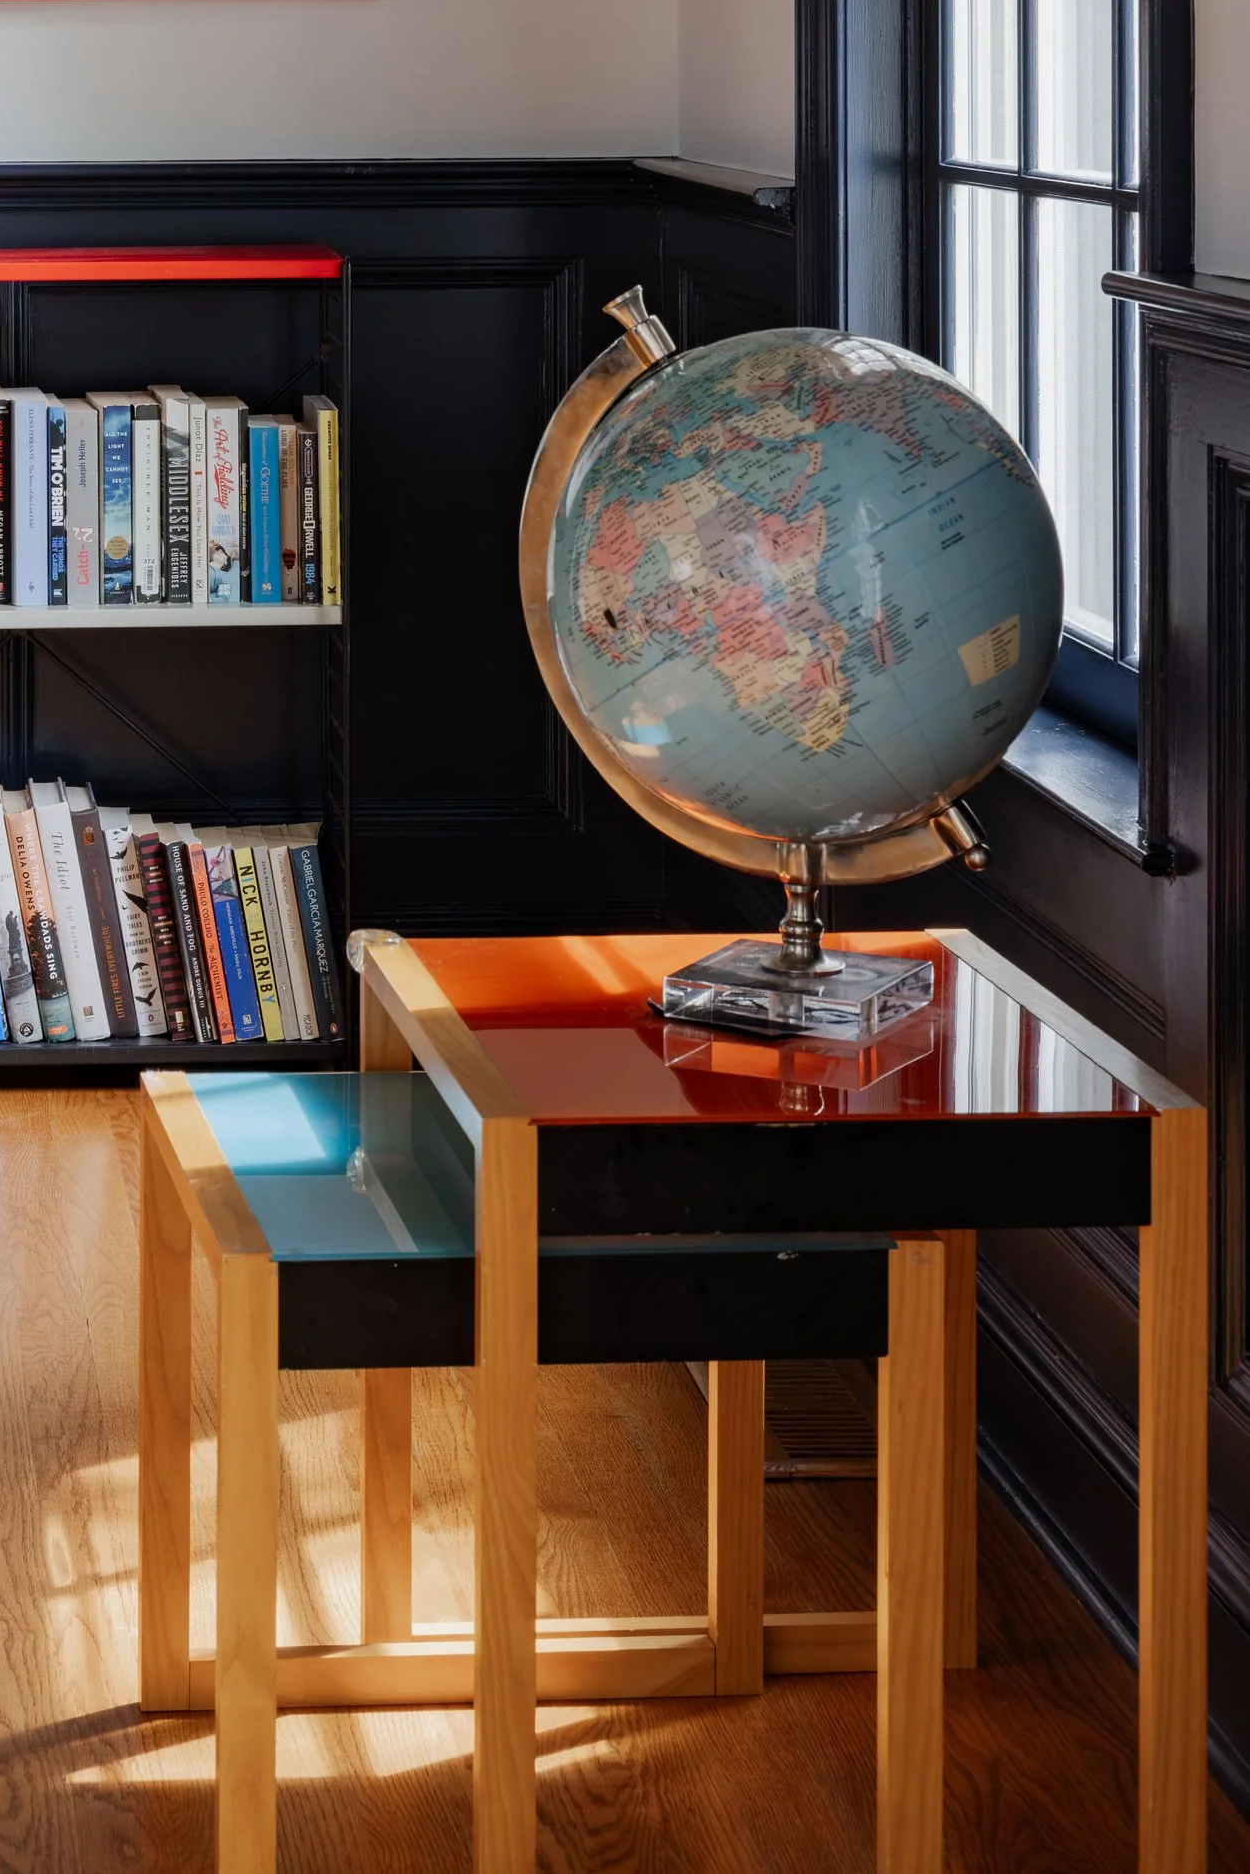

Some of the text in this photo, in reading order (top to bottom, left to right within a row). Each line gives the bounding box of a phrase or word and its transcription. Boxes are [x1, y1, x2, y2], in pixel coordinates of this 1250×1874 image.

[194, 417, 202, 440] Junot
[51, 446, 64, 526] TIM O'BRIEN
[169, 457, 189, 542] MIDDLESEX
[214, 429, 234, 509] Art Fielding
[171, 548, 179, 588] EUGENIDES
[179, 552, 187, 583] JEFFREY
[304, 488, 315, 584] GEORGE ORWELL 1984
[16, 836, 35, 910] DELIA OWENS
[51, 832, 70, 890] The Idiot
[115, 873, 140, 883] PULLMAN
[117, 864, 135, 873] PHILIP
[264, 876, 272, 906] Steinbeck
[25, 823, 58, 980] WHERE THE CRAWDADS SING
[172, 846, 196, 951] HOUSE OF SAND AND FOG
[239, 866, 276, 1003] NICK HORNBY
[301, 850, 328, 973] GABRIEL MÁRQUEZ
[102, 926, 125, 1018] LITTLE FIRES EVERYWHERE
[126, 938, 151, 947] BROTHERS
[131, 948, 148, 956] GRIMM
[198, 882, 223, 1000] PAULO COELHO ALCHEMIST
[195, 979, 203, 999] DUBUS
